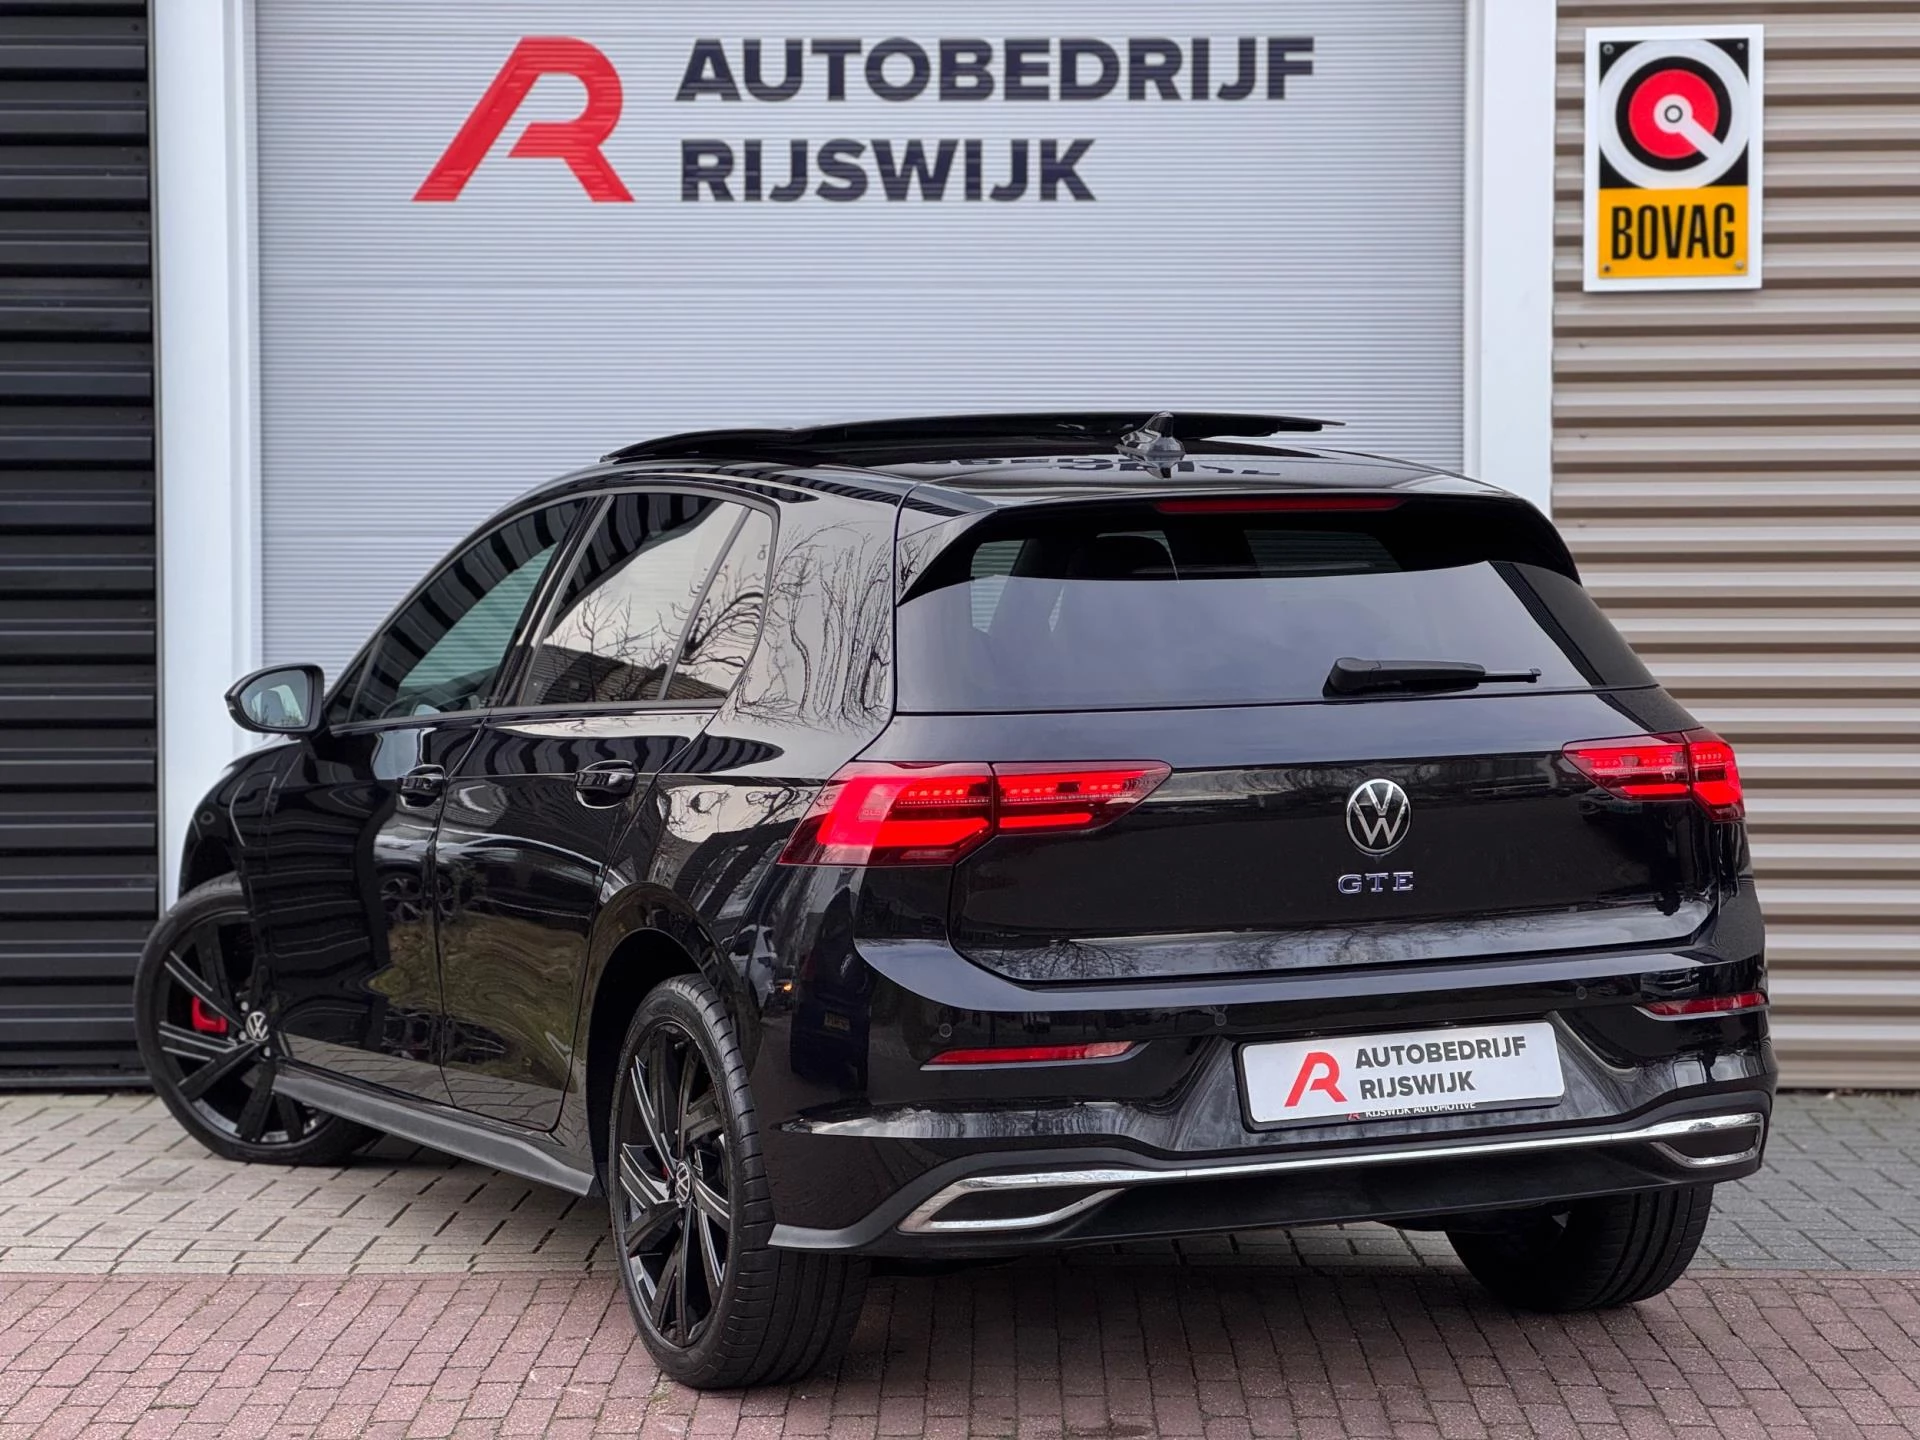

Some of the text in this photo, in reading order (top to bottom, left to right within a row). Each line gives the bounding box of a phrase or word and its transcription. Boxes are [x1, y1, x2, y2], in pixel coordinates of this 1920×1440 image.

[676, 37, 1314, 102] AUTOBEDRIJF
[681, 138, 1096, 202] RIJSWIJK
[1611, 203, 1735, 260] BOVAG
[1337, 871, 1414, 894] GTE
[1355, 1036, 1526, 1069] AUTOBEDRIJF
[1359, 1070, 1476, 1100] RIJSWIJK
